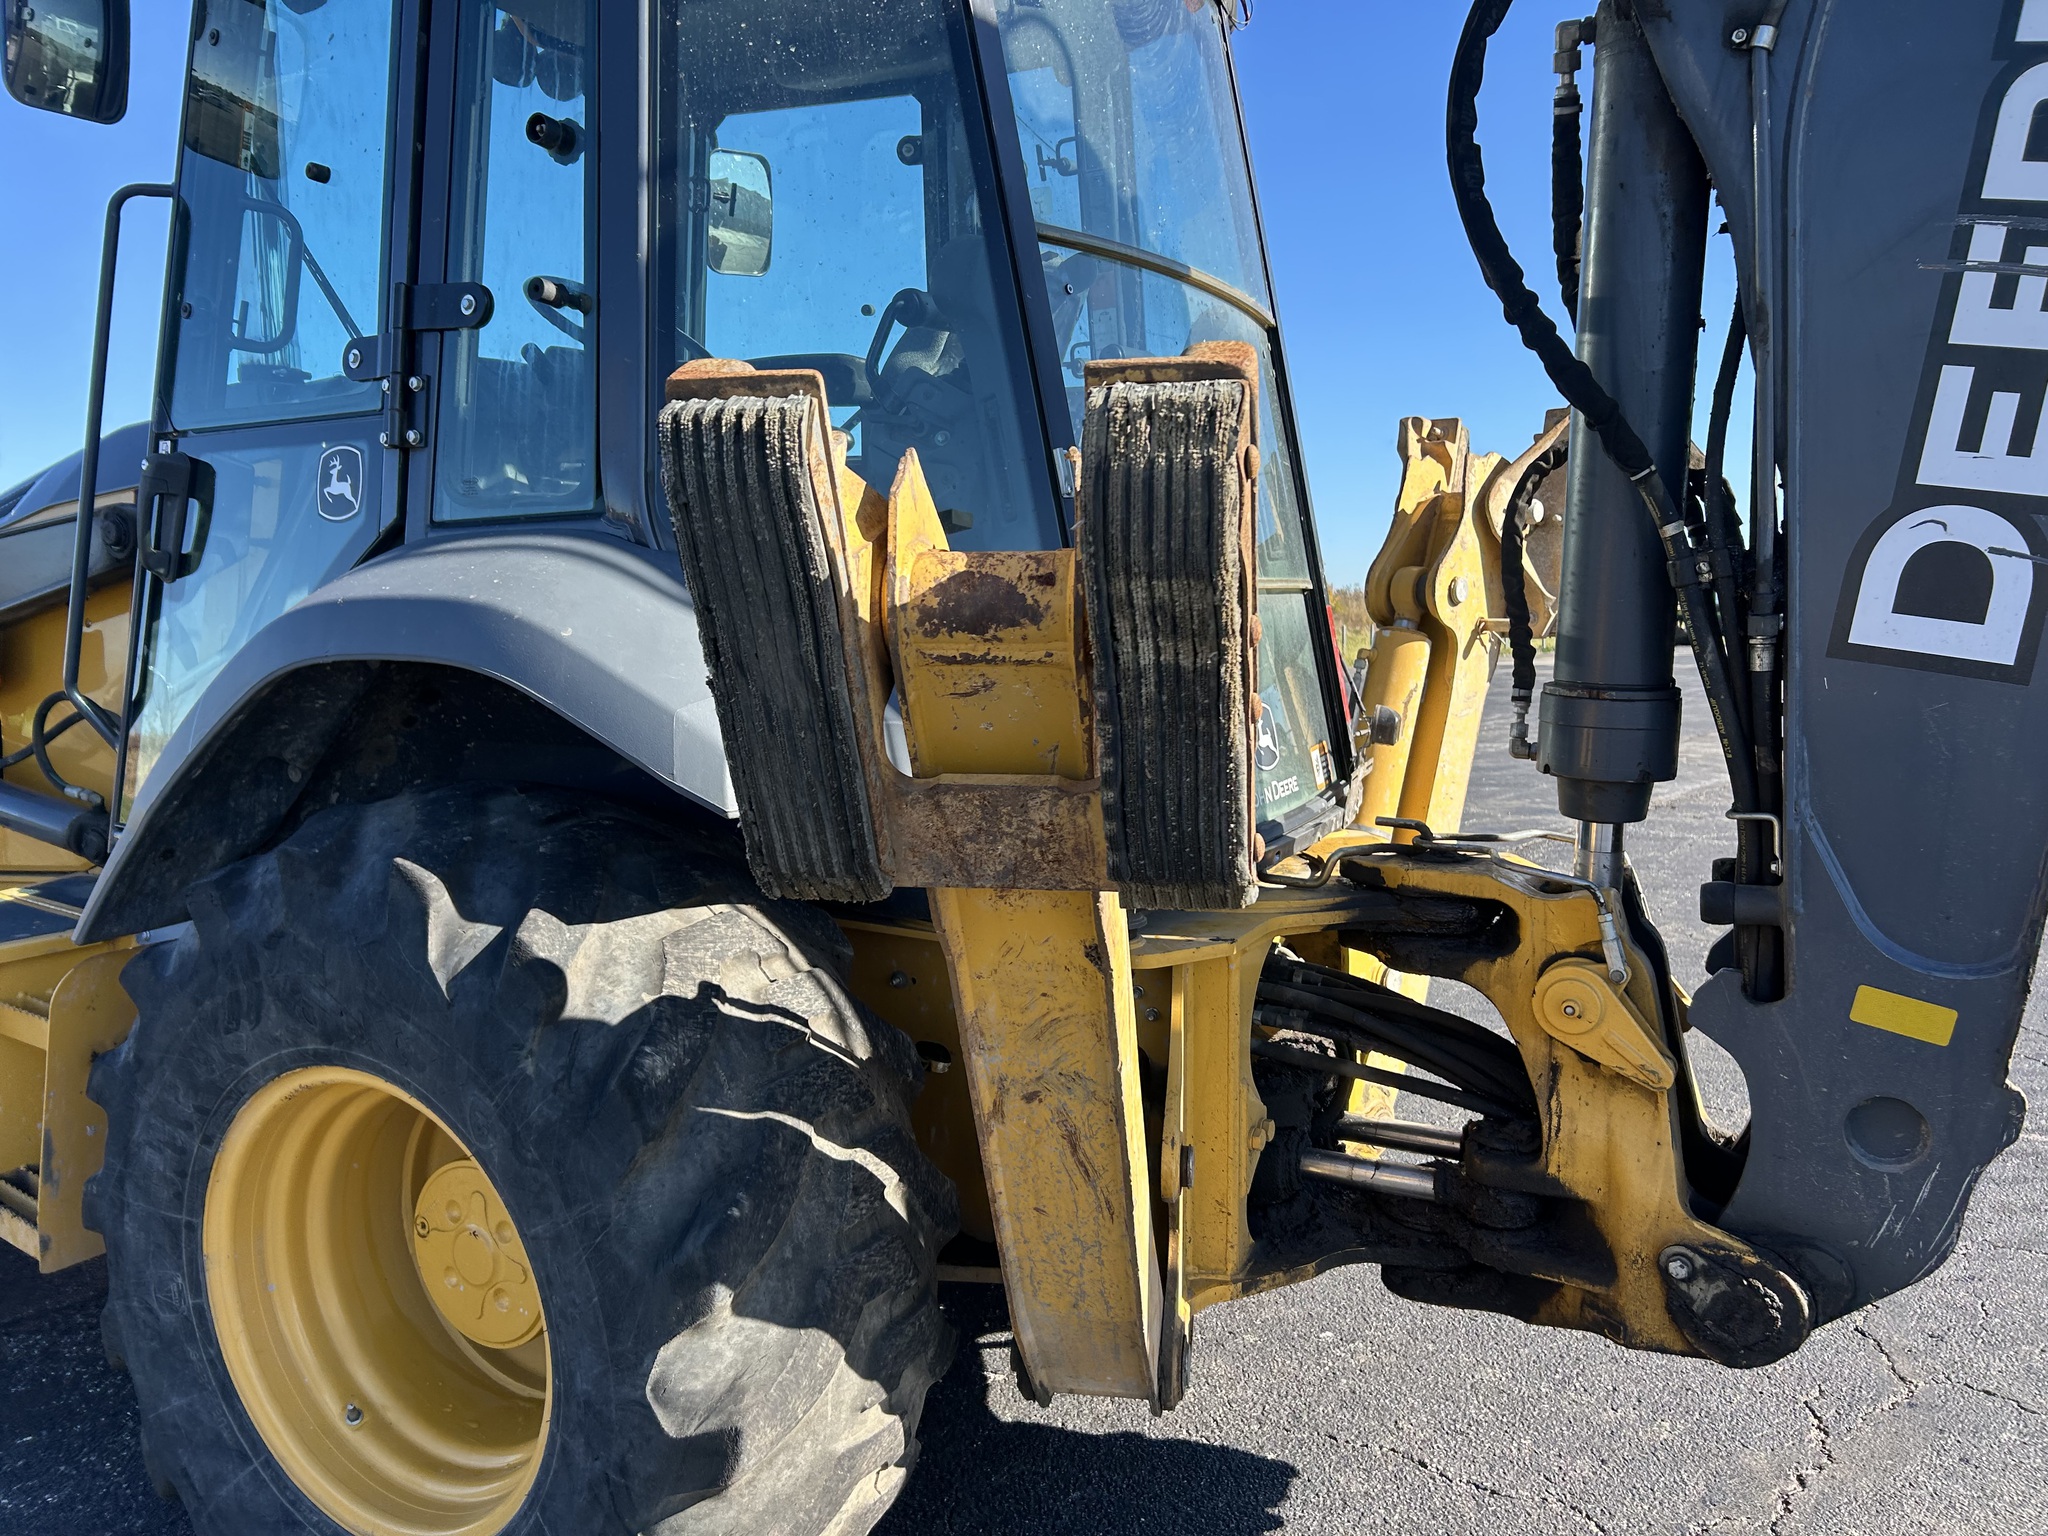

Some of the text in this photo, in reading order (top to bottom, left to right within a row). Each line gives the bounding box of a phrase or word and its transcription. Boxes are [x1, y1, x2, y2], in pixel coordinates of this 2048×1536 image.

[1848, 0, 2048, 666] DEE
[1710, 697, 1726, 735] AEROQUIP
[1271, 775, 1299, 800] DEERE
